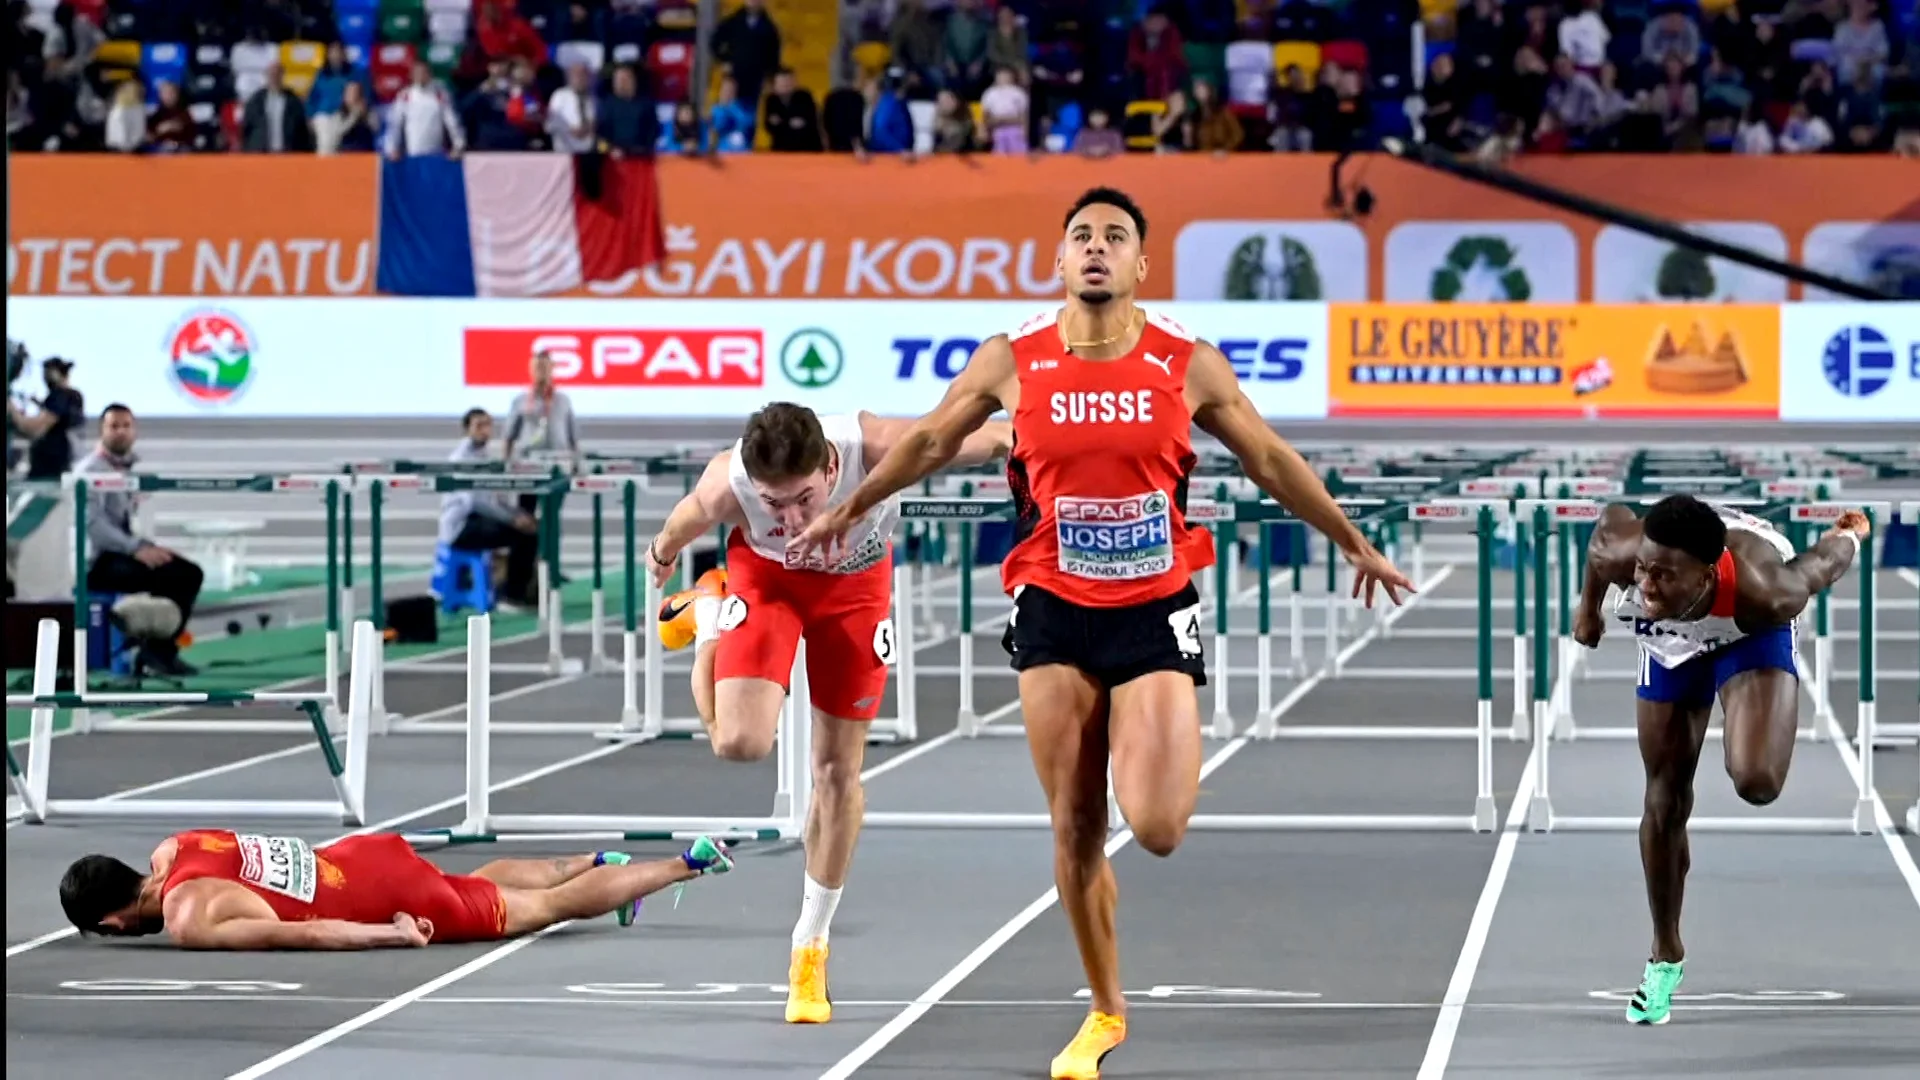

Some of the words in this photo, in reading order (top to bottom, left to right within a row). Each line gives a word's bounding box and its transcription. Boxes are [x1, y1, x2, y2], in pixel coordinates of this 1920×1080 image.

[1350, 317, 1390, 358] LE
[1400, 312, 1565, 358] GRUYÈRE
[531, 335, 761, 379] SPAR
[1354, 366, 1559, 382] SWITZERLAND
[906, 504, 956, 515] ISTANBUL
[959, 504, 985, 515] 2023
[1060, 501, 1139, 520] SPAR
[1062, 518, 1165, 550] JOSEPH
[882, 627, 891, 660] 5
